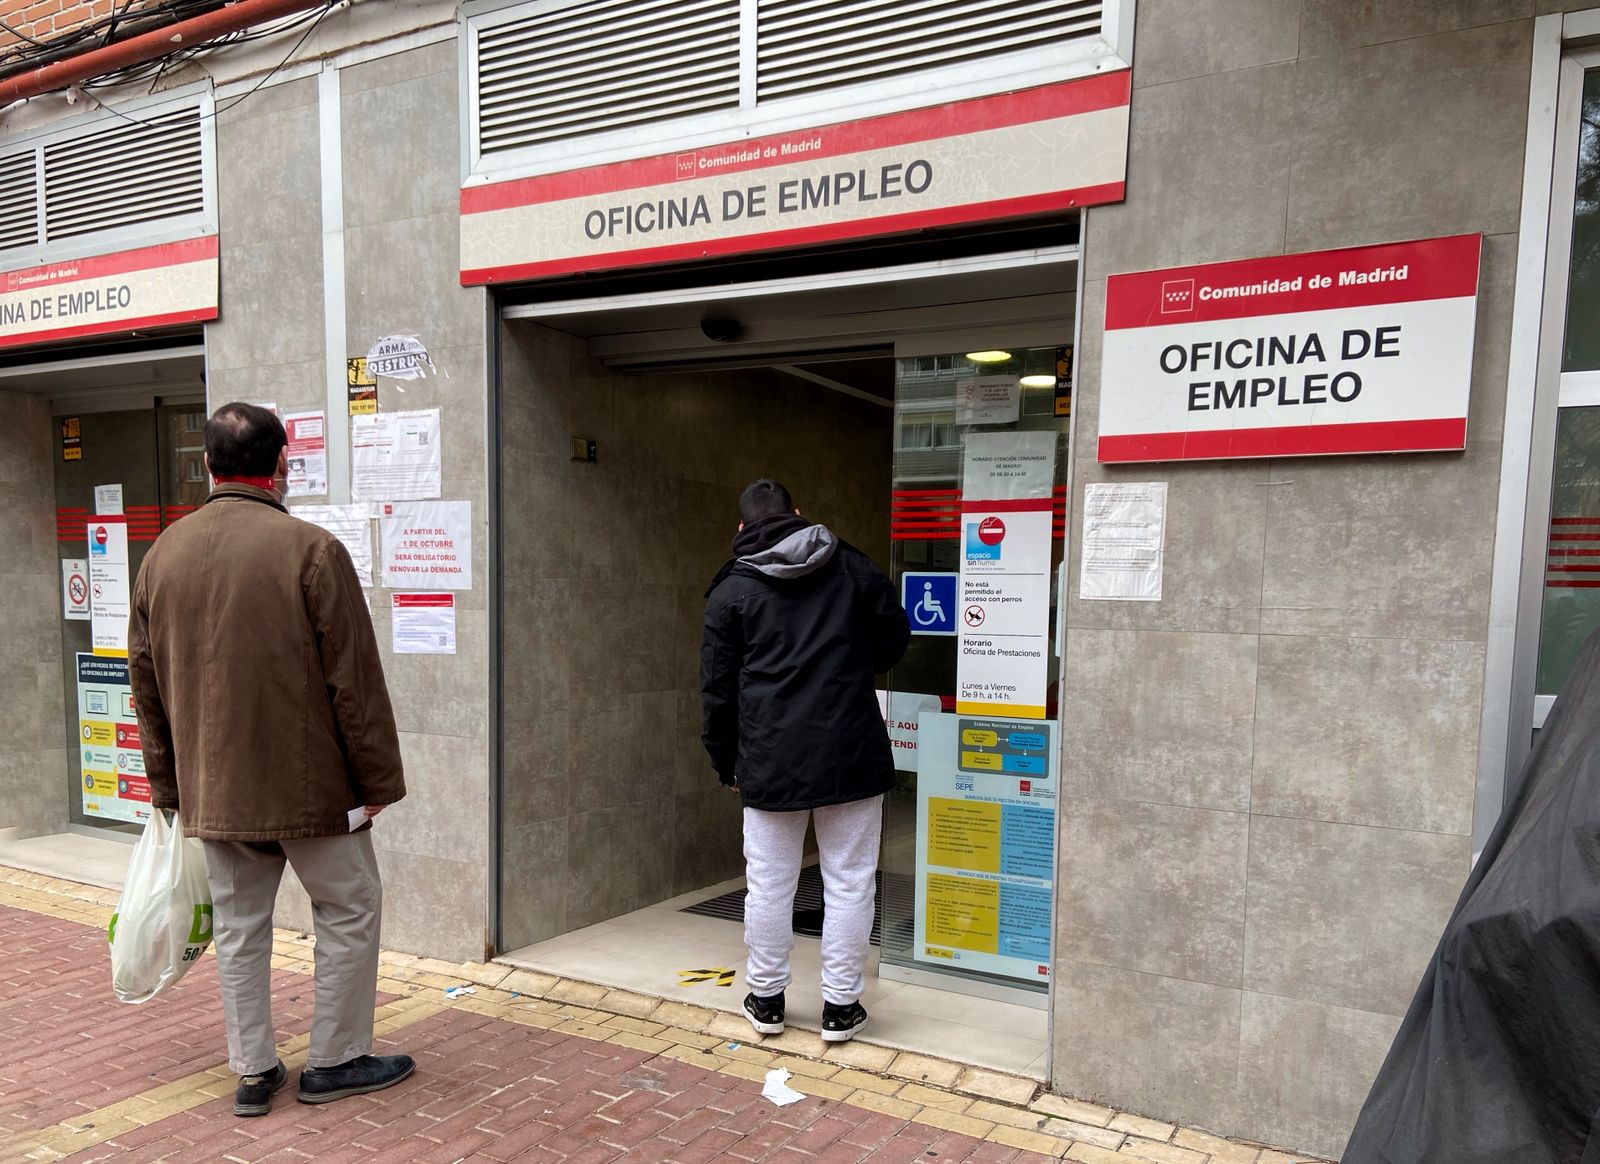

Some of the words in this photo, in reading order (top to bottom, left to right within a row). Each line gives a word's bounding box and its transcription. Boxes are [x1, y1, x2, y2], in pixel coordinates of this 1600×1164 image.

[698, 149, 760, 170] Comunidad
[763, 146, 778, 161] de
[780, 138, 822, 158] Madrid
[584, 194, 712, 240] OFICINA
[722, 181, 767, 222] DE
[778, 158, 934, 213] EMPLEO
[19, 271, 49, 285] Comunidad
[50, 271, 57, 279] de
[58, 267, 79, 279] Madrid
[1199, 276, 1303, 302] Comunidad
[1308, 272, 1332, 290] de
[1339, 264, 1409, 288] Madrid
[31, 297, 53, 321] DE
[58, 285, 131, 317] EMPLEO
[379, 343, 406, 355] ARMA
[1159, 332, 1327, 374] OFICINA
[1341, 325, 1402, 361] DE
[369, 353, 428, 374] DESTRUR
[1187, 371, 1363, 412] EMPLEO
[994, 454, 1017, 462] ATENCIÓN
[420, 540, 454, 548] OCTUBRE
[413, 553, 457, 561] OBLIGATORIO
[967, 551, 991, 560] espacio
[389, 565, 420, 573] RENOVAR
[430, 566, 463, 574] DEMANDA
[975, 580, 989, 588] está
[965, 588, 994, 596] permitido
[1001, 596, 1023, 604] perros
[963, 638, 992, 647] Horario
[963, 648, 986, 656] Oficina
[987, 648, 996, 656] de
[997, 648, 1041, 658] Prestaciones
[962, 682, 983, 690] Lunes
[990, 682, 1016, 692] Viernes
[962, 690, 971, 698] De
[973, 691, 978, 699] 9
[979, 691, 986, 699] h.
[994, 692, 1003, 700] 14
[955, 782, 975, 792] SEPE
